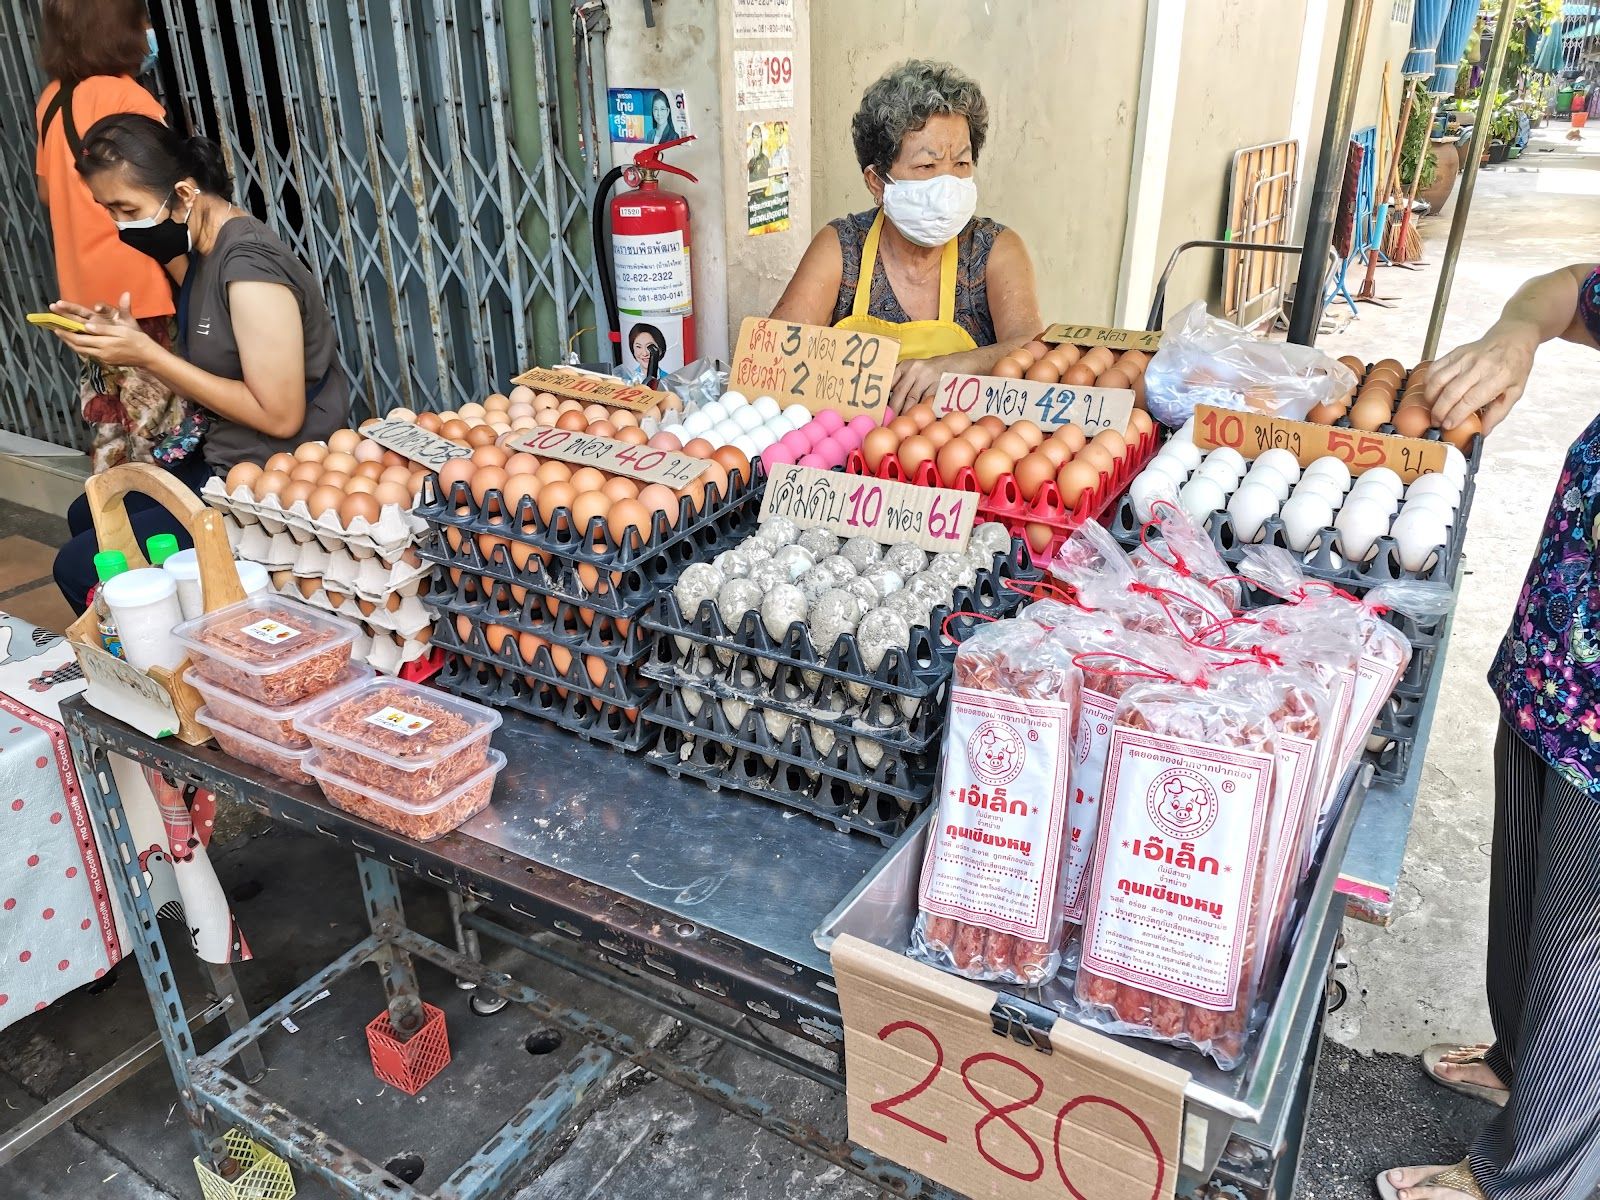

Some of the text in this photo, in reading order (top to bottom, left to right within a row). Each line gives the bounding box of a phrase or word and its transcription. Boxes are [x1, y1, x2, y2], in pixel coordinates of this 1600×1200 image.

[764, 57, 792, 84] 199
[616, 98, 634, 112] ไทย
[617, 125, 635, 137] ไทย
[622, 271, 673, 282] 02-622-2322
[638, 290, 684, 302] 081-830-0141
[749, 320, 880, 368] เค็ม 3 ฟอง 20
[1058, 326, 1091, 340] 10
[1097, 328, 1128, 342] ฟอง
[568, 379, 598, 392] 10
[591, 382, 616, 396] ฟอง
[612, 387, 644, 402] 42
[790, 361, 810, 396] 2
[816, 368, 845, 403] ฟอง
[847, 370, 883, 410] 15
[940, 377, 1111, 427] 10 ฟอง 42 บ.
[368, 421, 415, 440] 10
[419, 441, 471, 464] 38
[523, 429, 689, 482] 10 ฟอง 40 บ.
[1201, 410, 1245, 449] 10
[1254, 422, 1301, 458] ฟอง
[1327, 431, 1387, 468] 55
[768, 466, 962, 540] เค็มดิบ 10 ฟอง 61
[57, 739, 73, 785] ma Cocotte
[71, 796, 88, 840] ma Cocotte
[86, 849, 102, 892] ma Cocotte
[1159, 876, 1188, 888] จำหน่าย
[99, 901, 110, 929] Cocotte
[1128, 899, 1147, 909] อร่อย
[1151, 906, 1174, 917] สะอาด
[870, 1020, 1165, 1200] 280
